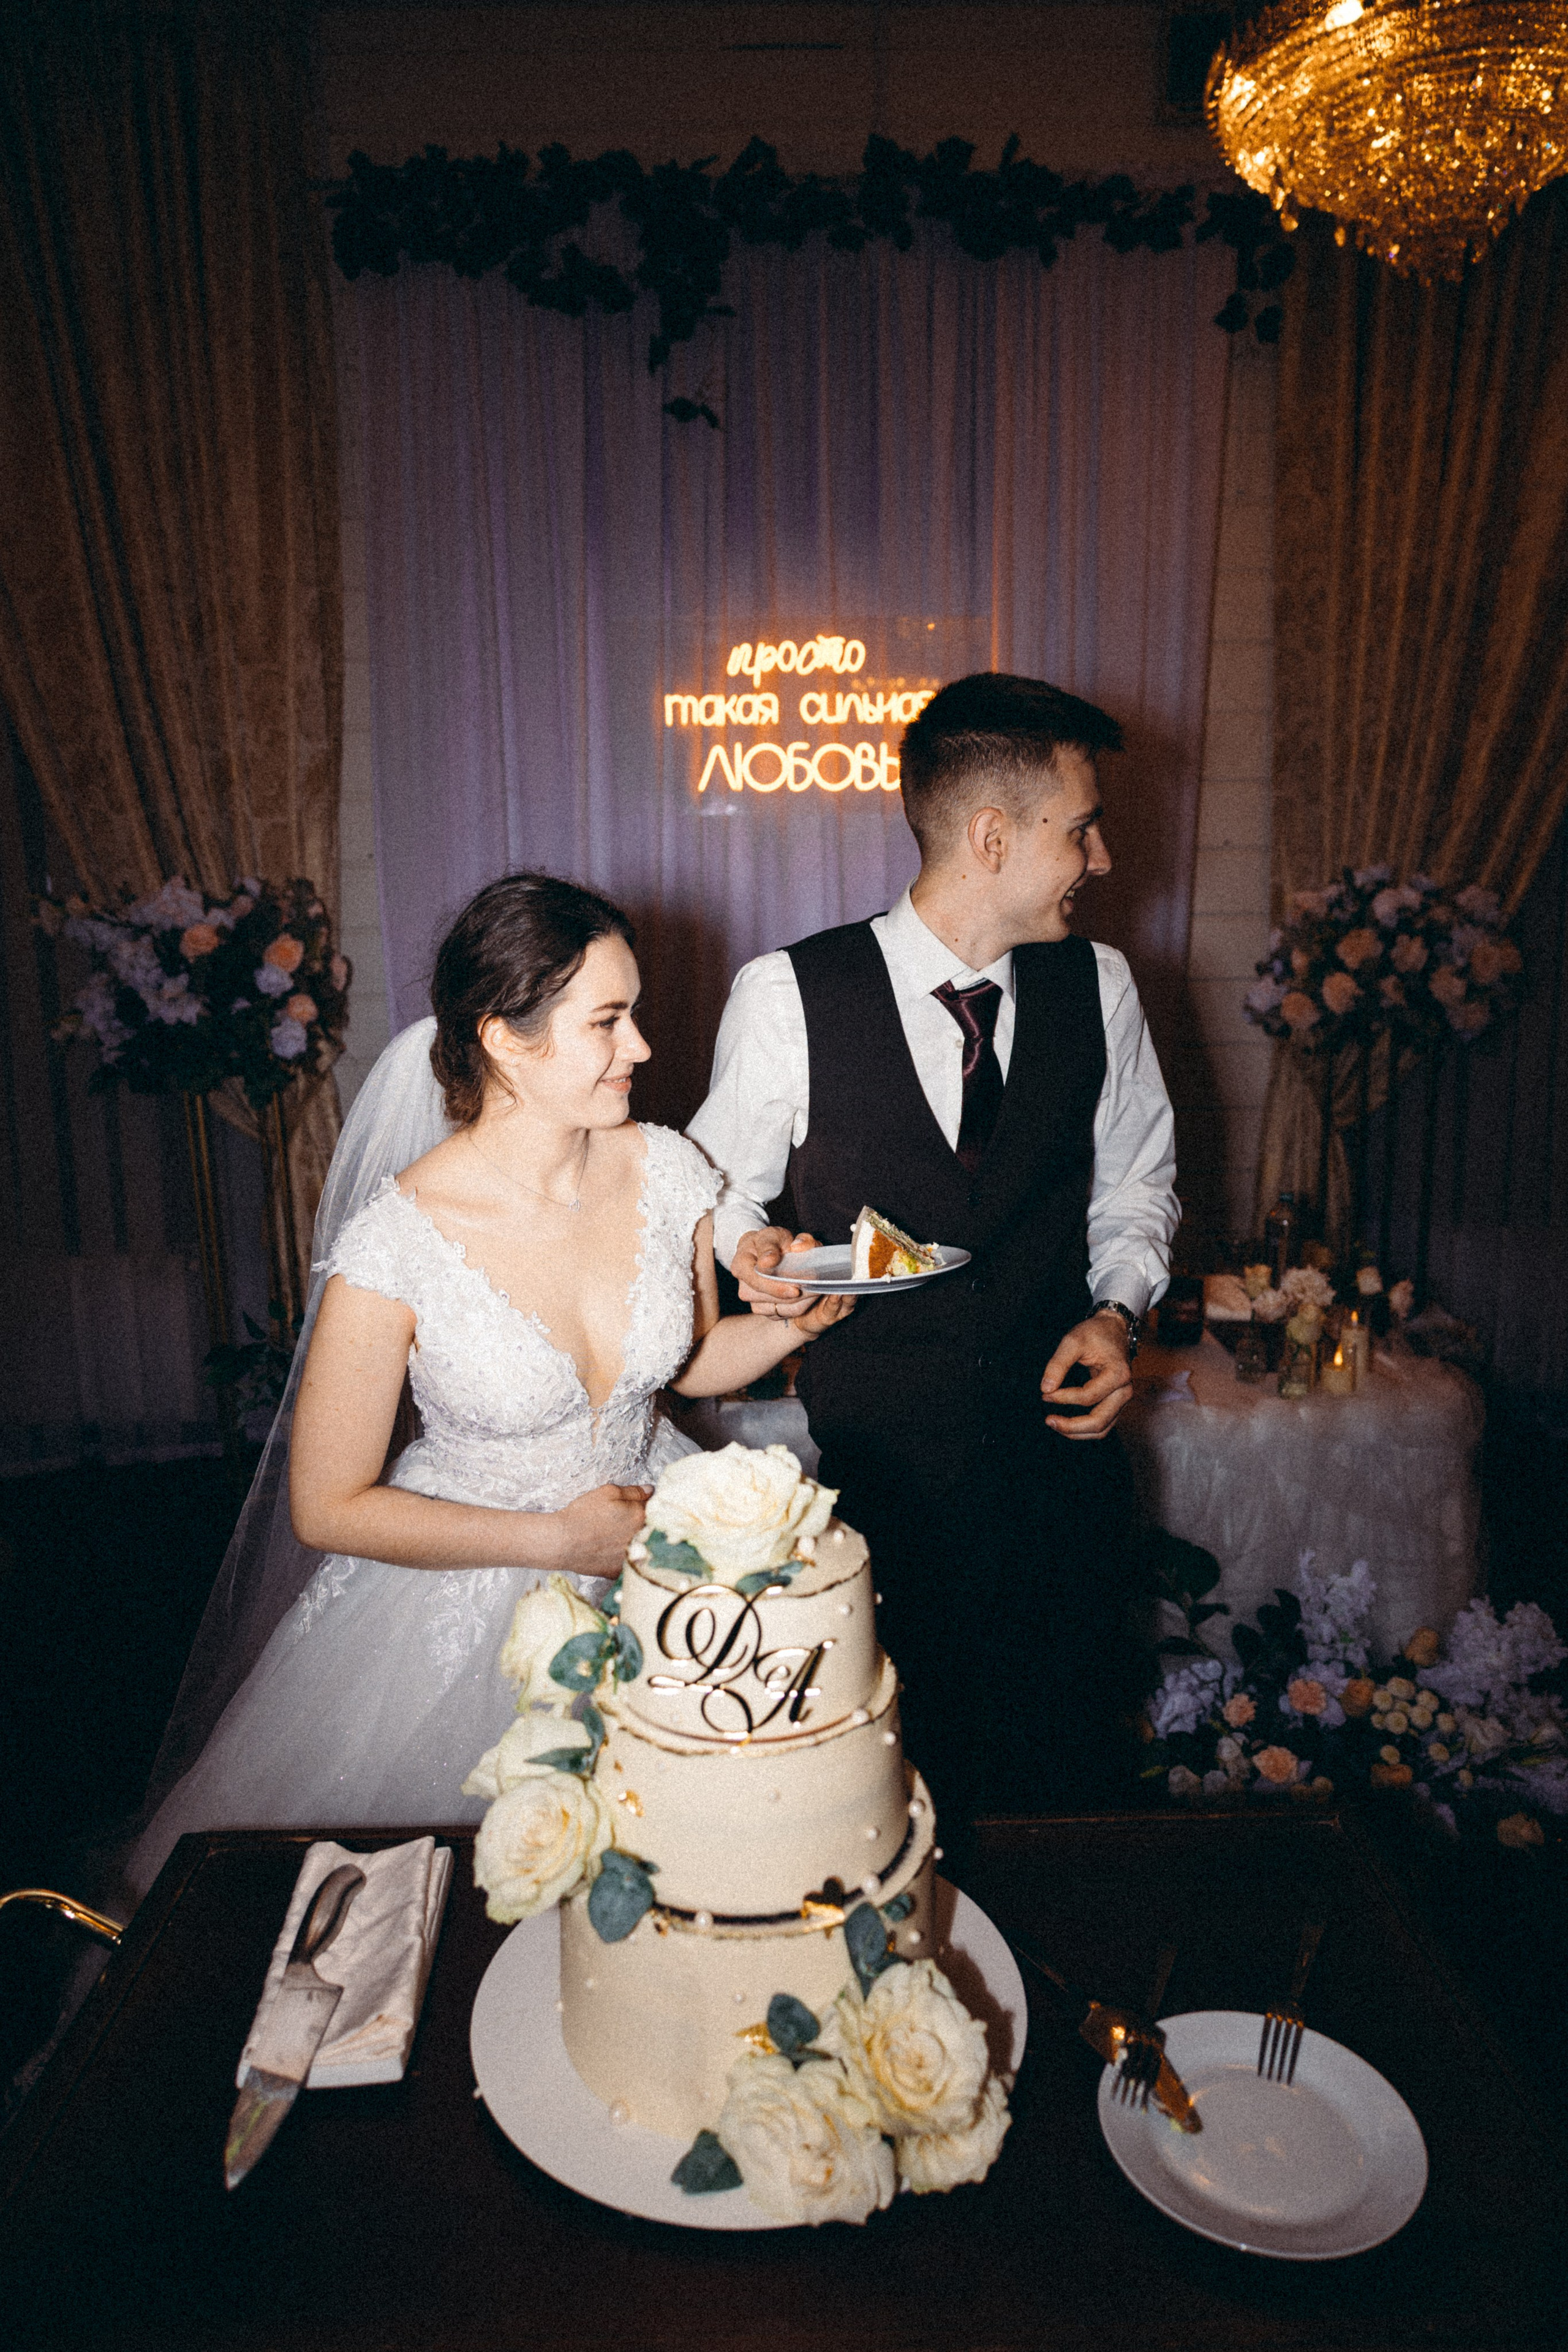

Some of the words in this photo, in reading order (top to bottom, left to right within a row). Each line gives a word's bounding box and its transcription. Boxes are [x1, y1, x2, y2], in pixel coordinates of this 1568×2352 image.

[726, 634, 866, 688] просто
[664, 692, 779, 727] такая
[697, 741, 902, 792] ЛЮБОВЬ
